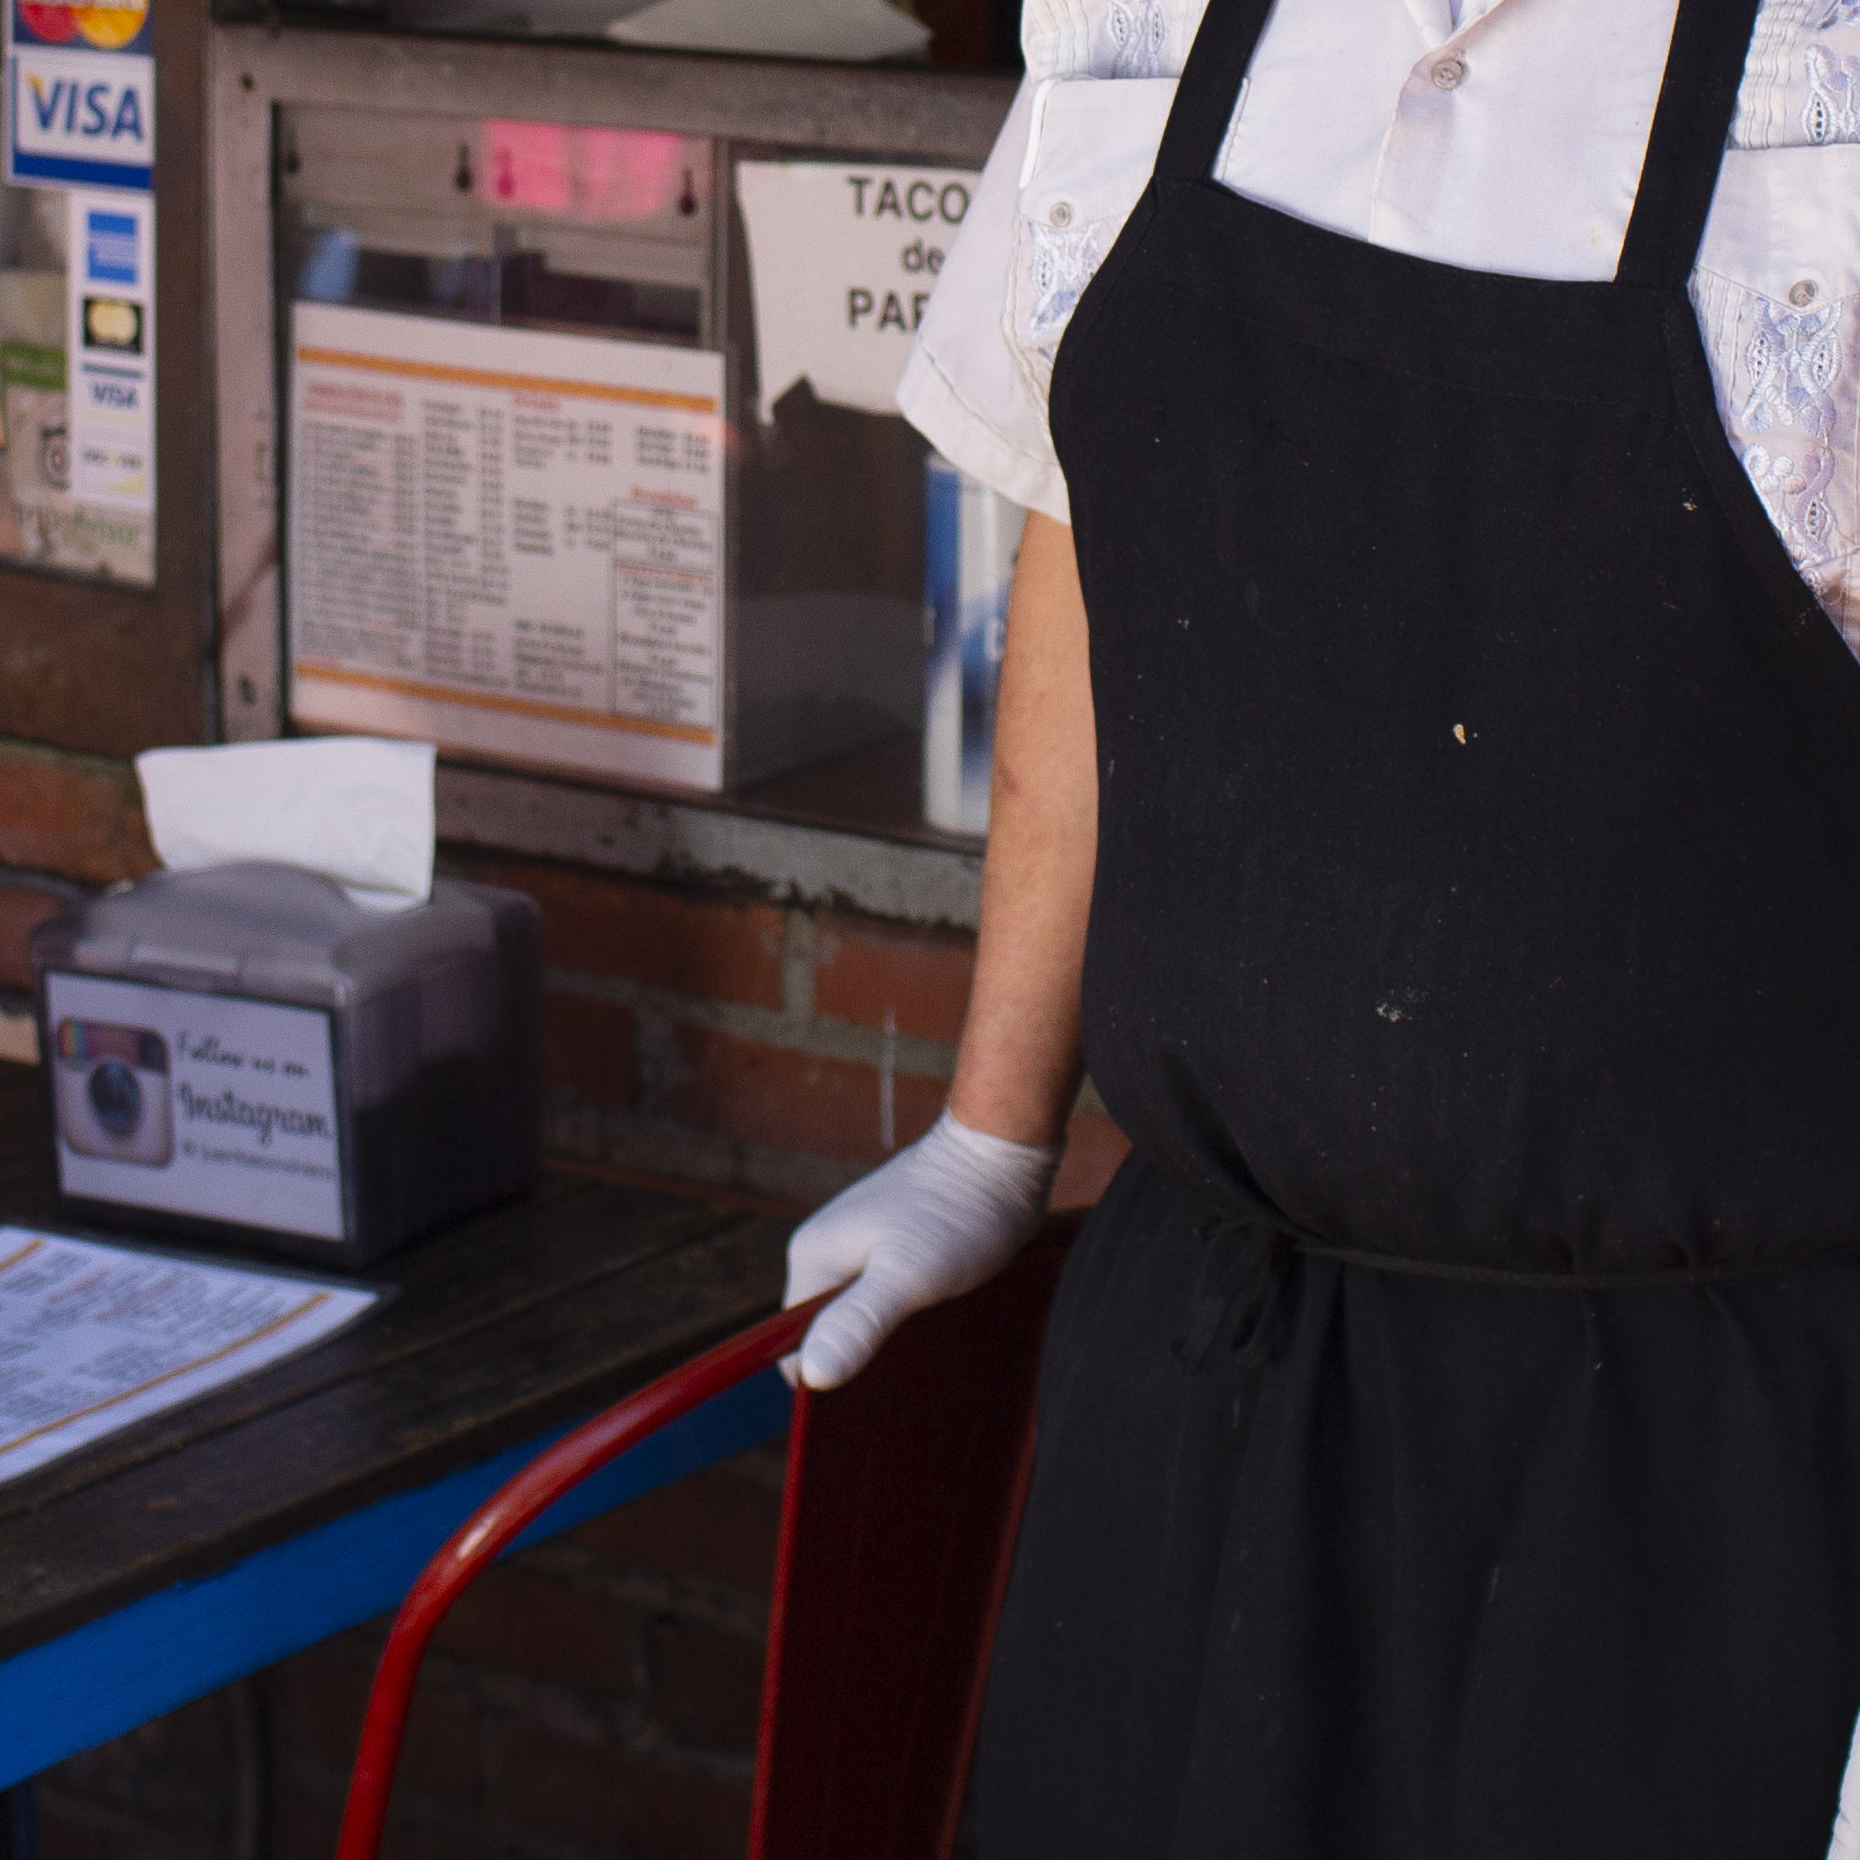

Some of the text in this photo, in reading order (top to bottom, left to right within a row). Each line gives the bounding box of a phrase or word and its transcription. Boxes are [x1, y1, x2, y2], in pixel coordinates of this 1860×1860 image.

[29, 73, 144, 142] VISA
[847, 174, 971, 225] TACO
[902, 238, 945, 275] de
[91, 381, 139, 410] VISA
[179, 1082, 329, 1148] Instagram
